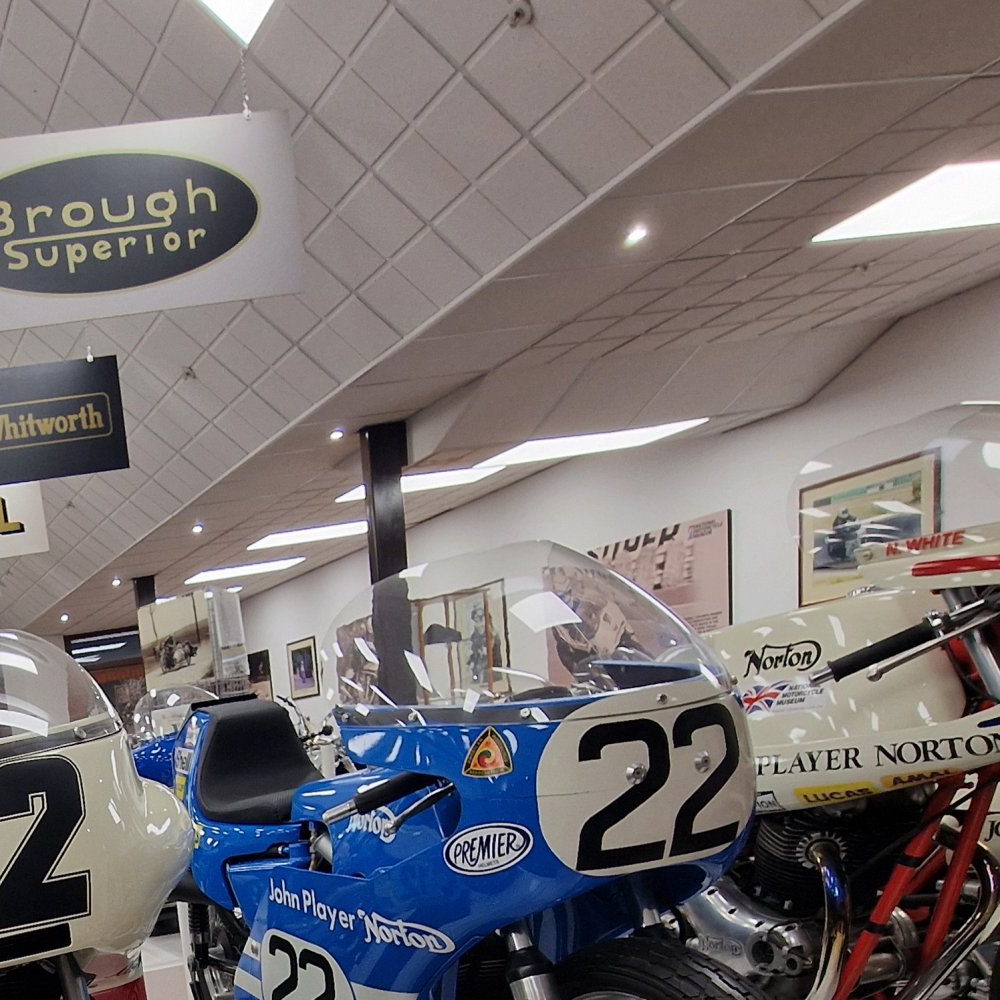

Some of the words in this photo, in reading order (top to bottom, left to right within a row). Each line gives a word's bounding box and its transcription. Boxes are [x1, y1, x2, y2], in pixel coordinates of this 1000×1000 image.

[3, 226, 206, 273] Superior
[906, 529, 966, 550] WHITE
[744, 640, 822, 677] Norton
[776, 697, 806, 706] MUSEUM
[757, 748, 863, 777] PLAYER
[577, 701, 740, 872] 22
[802, 786, 873, 804] LUCAS
[453, 831, 527, 868] PREMIER
[269, 878, 301, 911] John
[302, 888, 356, 931] Player
[358, 908, 456, 954] Norton
